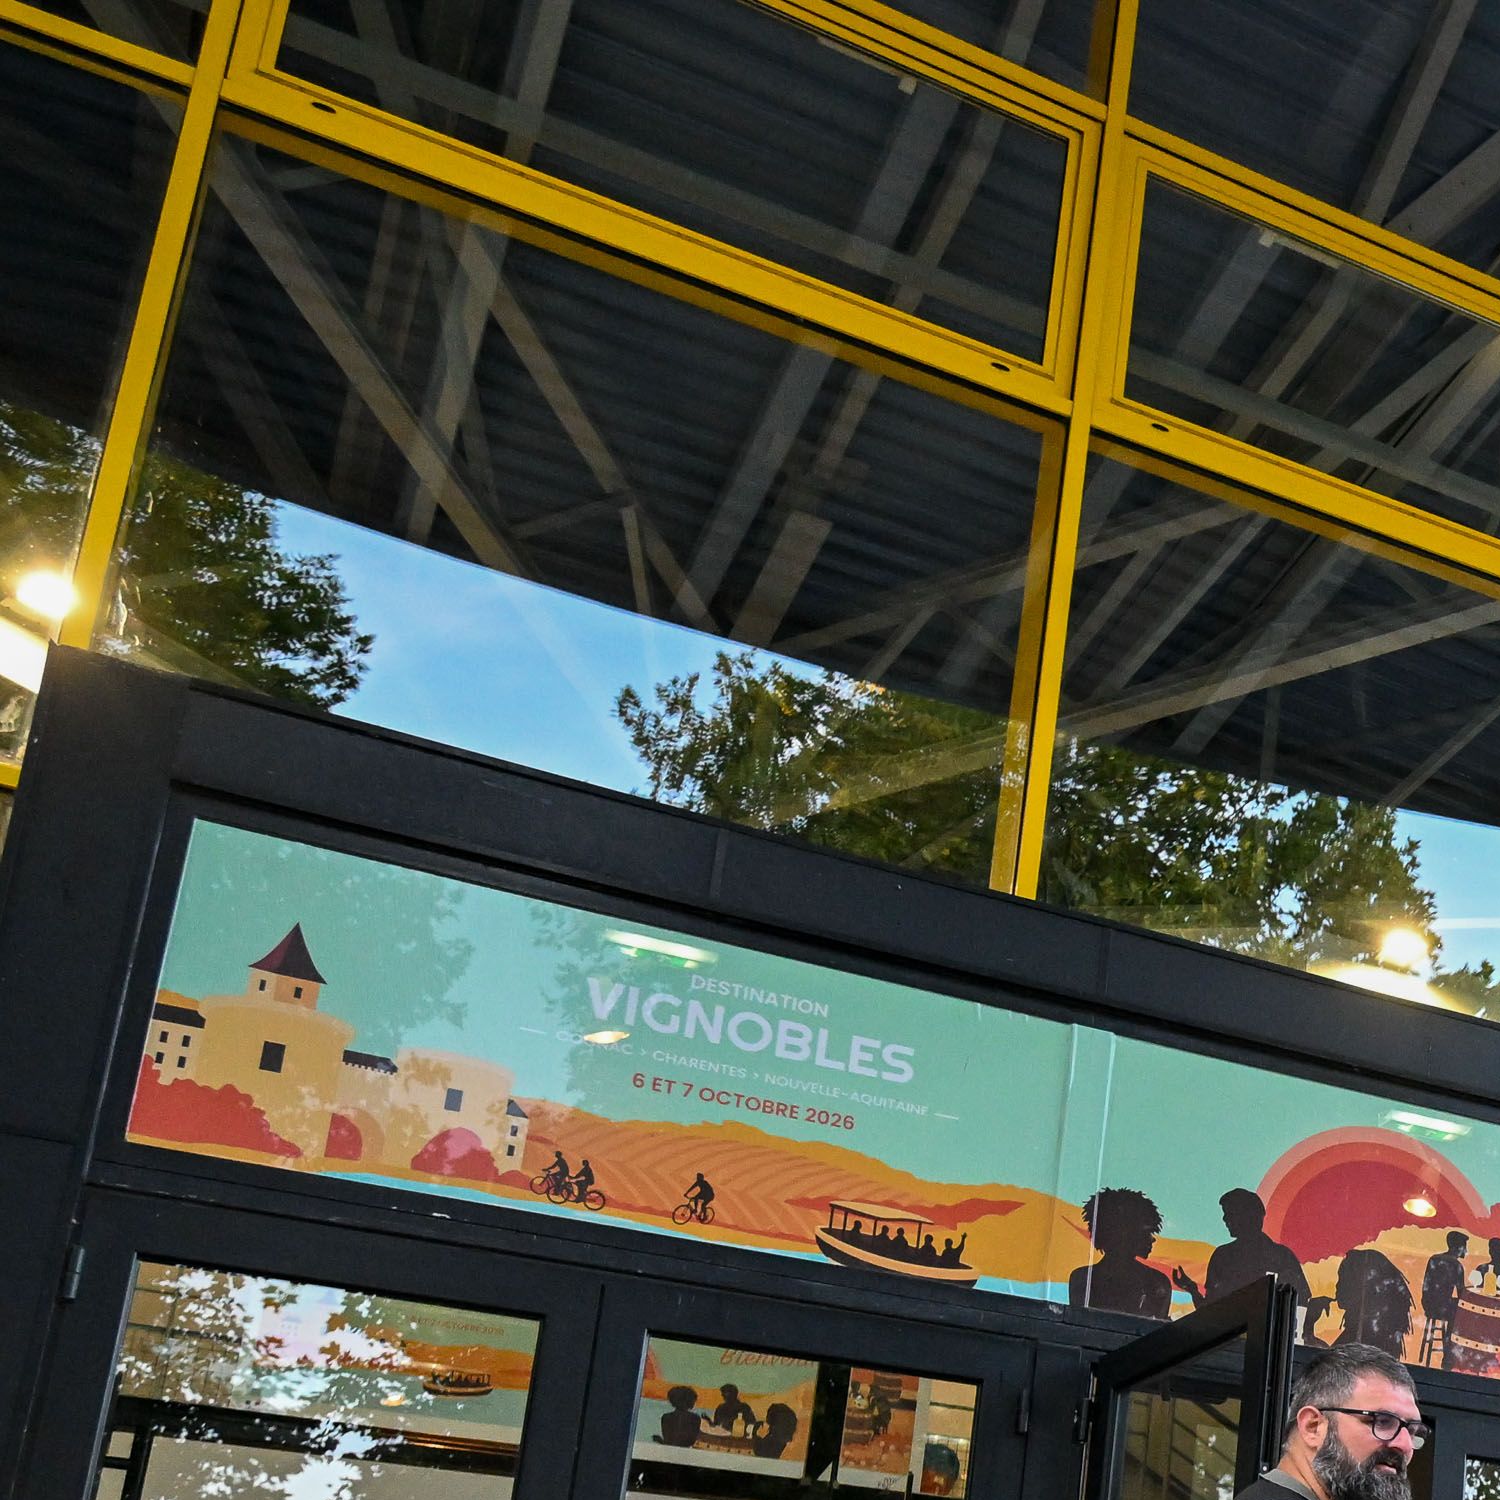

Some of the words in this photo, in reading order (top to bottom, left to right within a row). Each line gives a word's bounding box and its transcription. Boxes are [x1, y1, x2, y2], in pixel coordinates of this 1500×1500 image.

[691, 974, 829, 1018] DESTINATION
[586, 976, 915, 1084] VIGNOBLES
[632, 1072, 646, 1090] 6
[652, 1077, 676, 1095] ET
[682, 1082, 694, 1099] 7
[699, 1087, 800, 1119] OCTOBRE
[804, 1107, 856, 1131] 2026
[652, 1049, 748, 1080] CHARENTES
[764, 1074, 930, 1116] NOUVELLE-AQUITAINE
